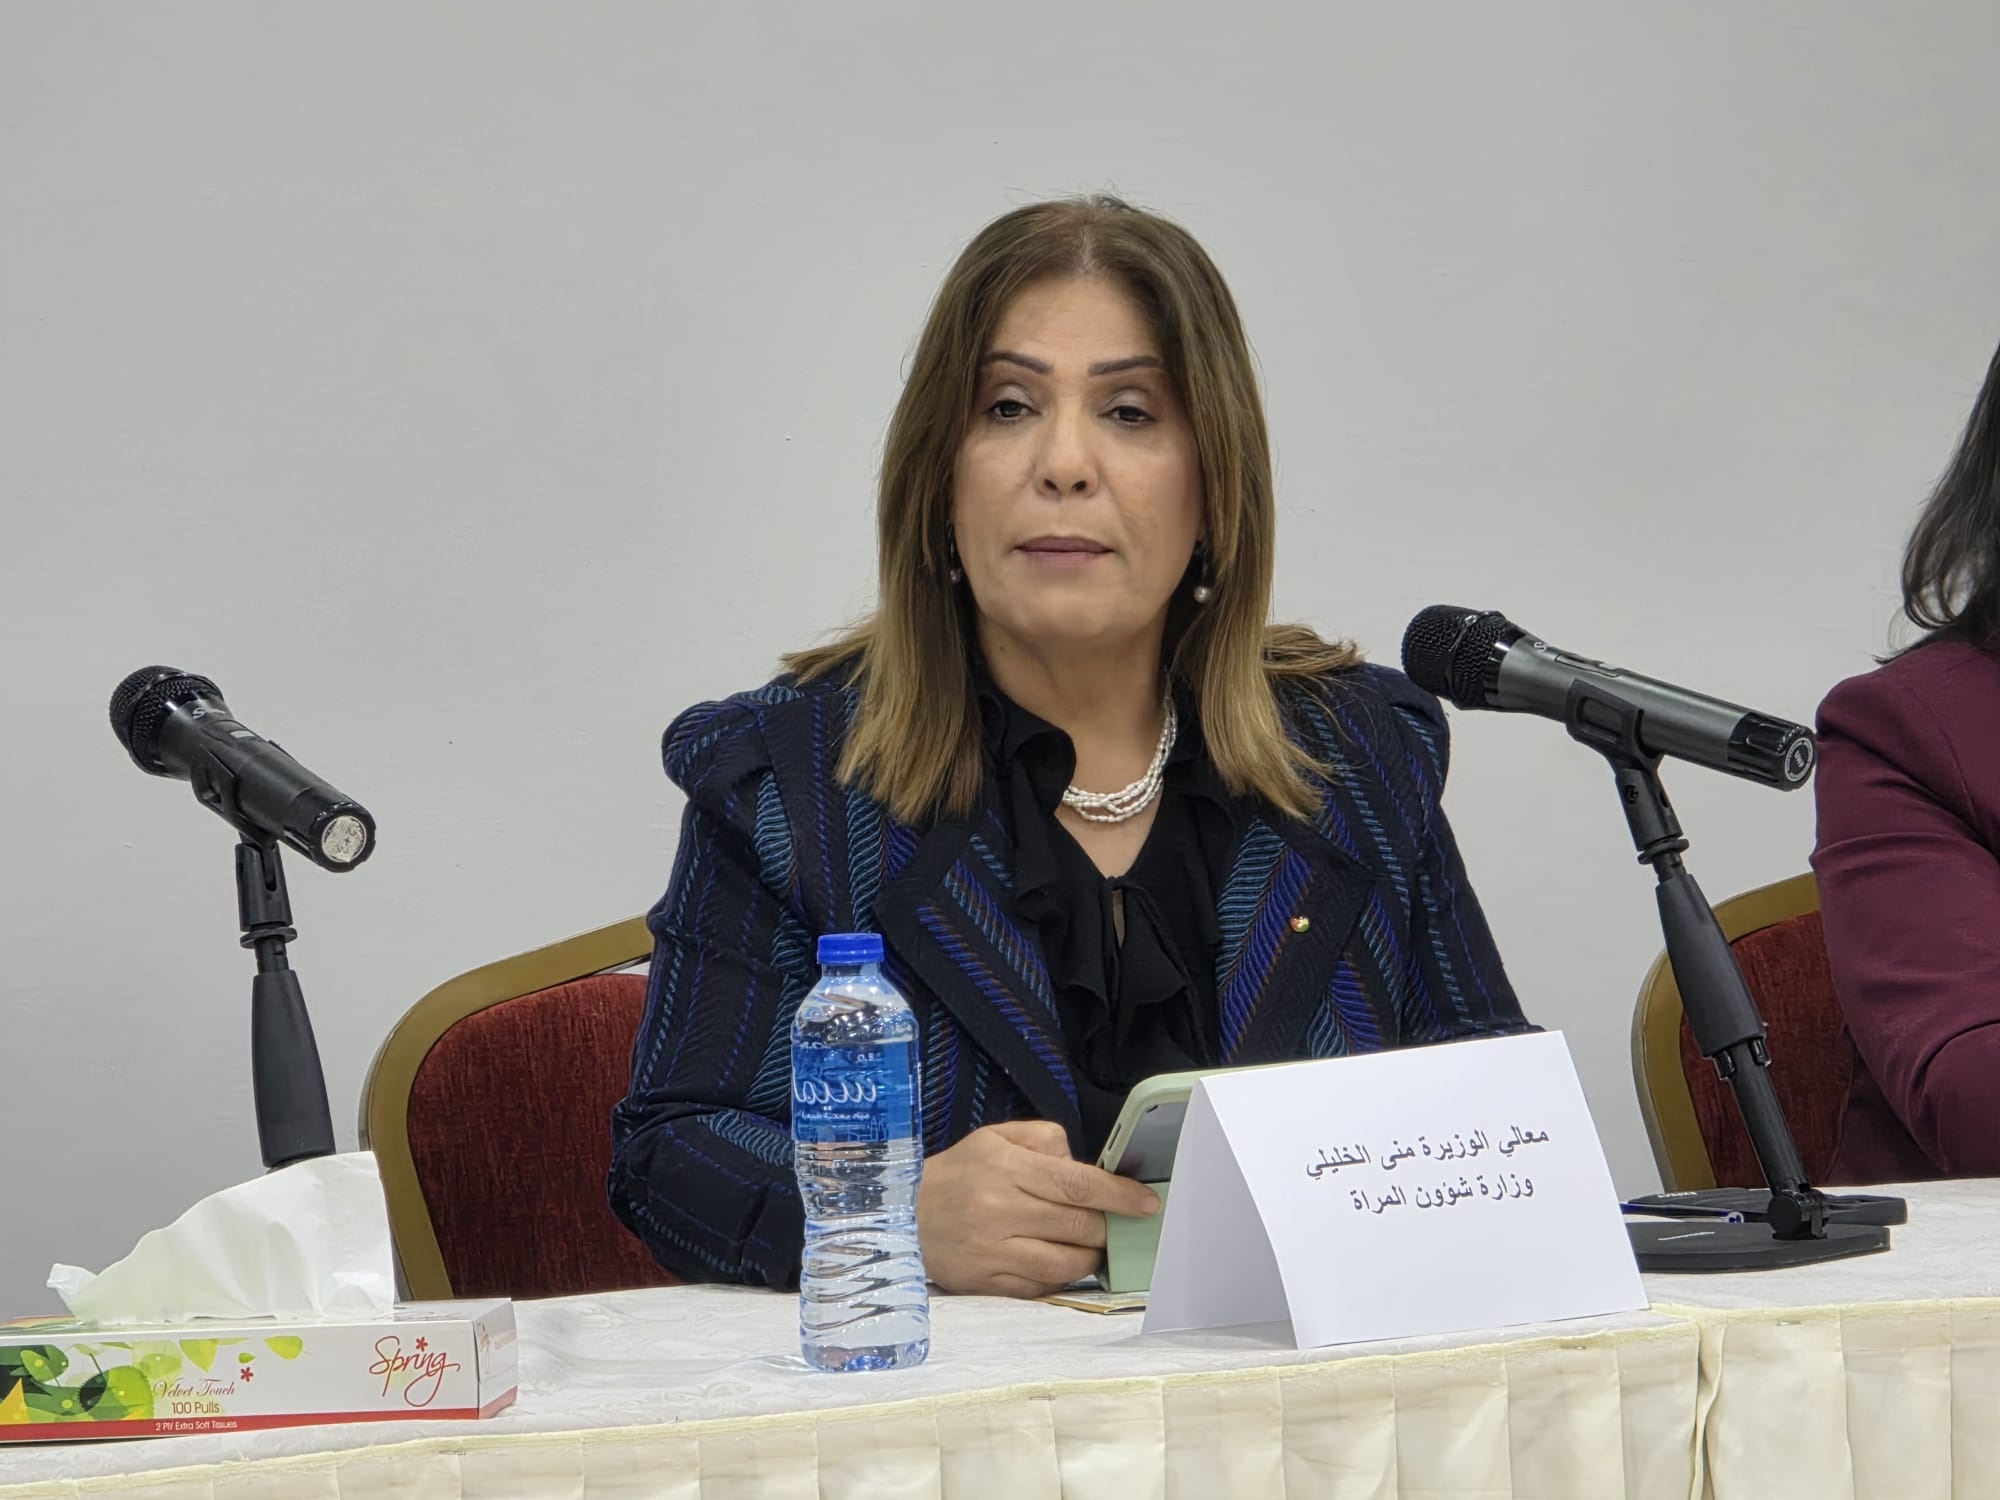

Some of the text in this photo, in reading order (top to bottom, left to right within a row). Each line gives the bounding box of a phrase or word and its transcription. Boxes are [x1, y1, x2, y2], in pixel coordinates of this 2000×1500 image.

[1306, 1124, 1549, 1181] معالي الوزيرة منى الخليلي
[1415, 1176, 1474, 1209] شؤون
[1475, 1173, 1534, 1201] وزارة
[369, 1335, 461, 1408] Spring
[153, 1377, 236, 1400] Velvet Touch
[171, 1400, 221, 1415] 100 Pulls
[155, 1422, 161, 1431] 2
[195, 1420, 210, 1430] Soft
[211, 1420, 239, 1430] Tissues
